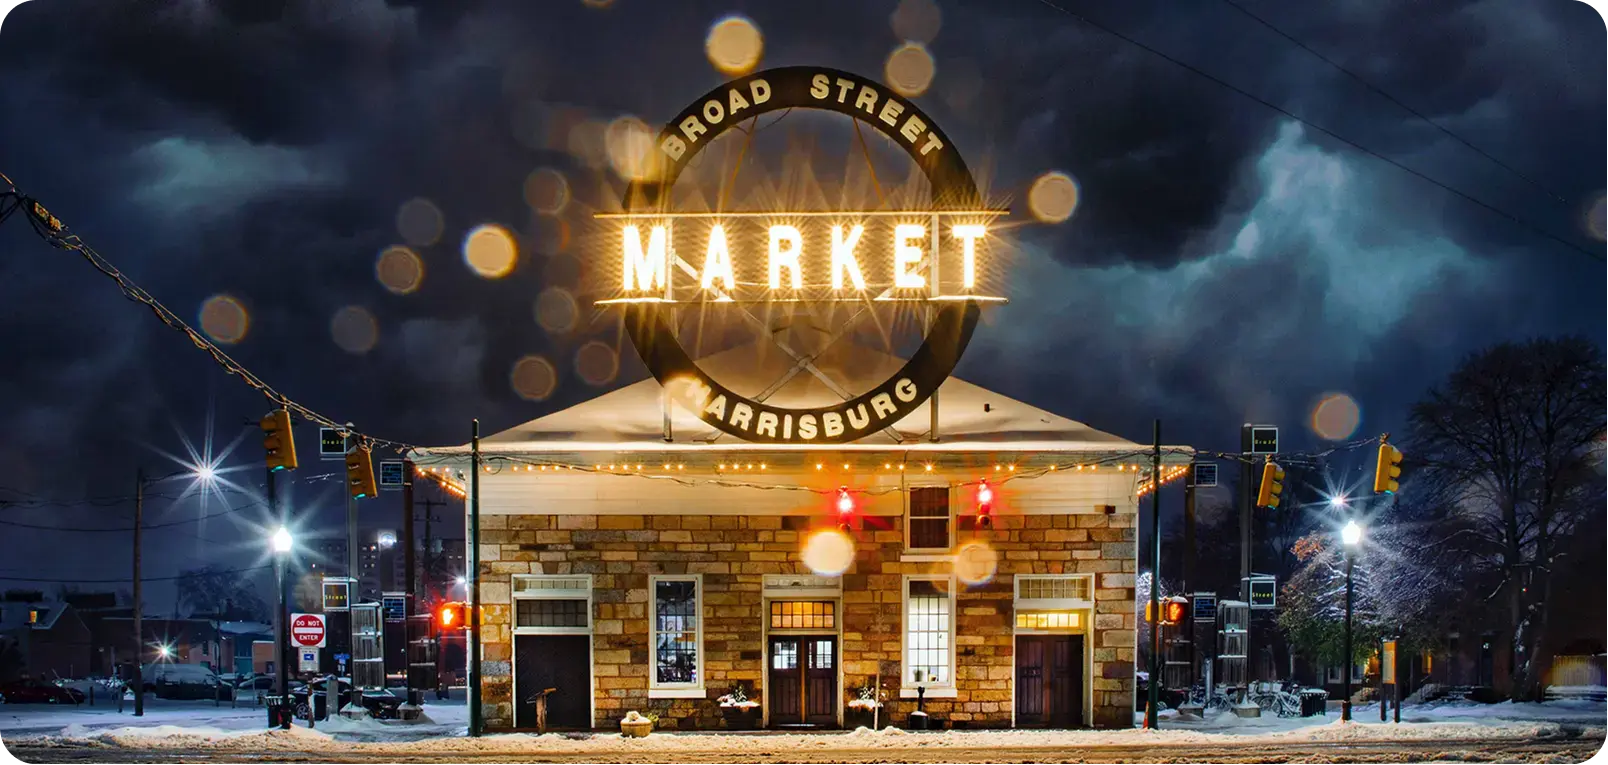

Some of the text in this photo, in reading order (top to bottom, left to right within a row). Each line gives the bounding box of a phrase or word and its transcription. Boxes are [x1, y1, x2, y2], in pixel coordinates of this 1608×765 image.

[660, 73, 944, 162] BROAD STREET
[622, 224, 986, 292] MARKET
